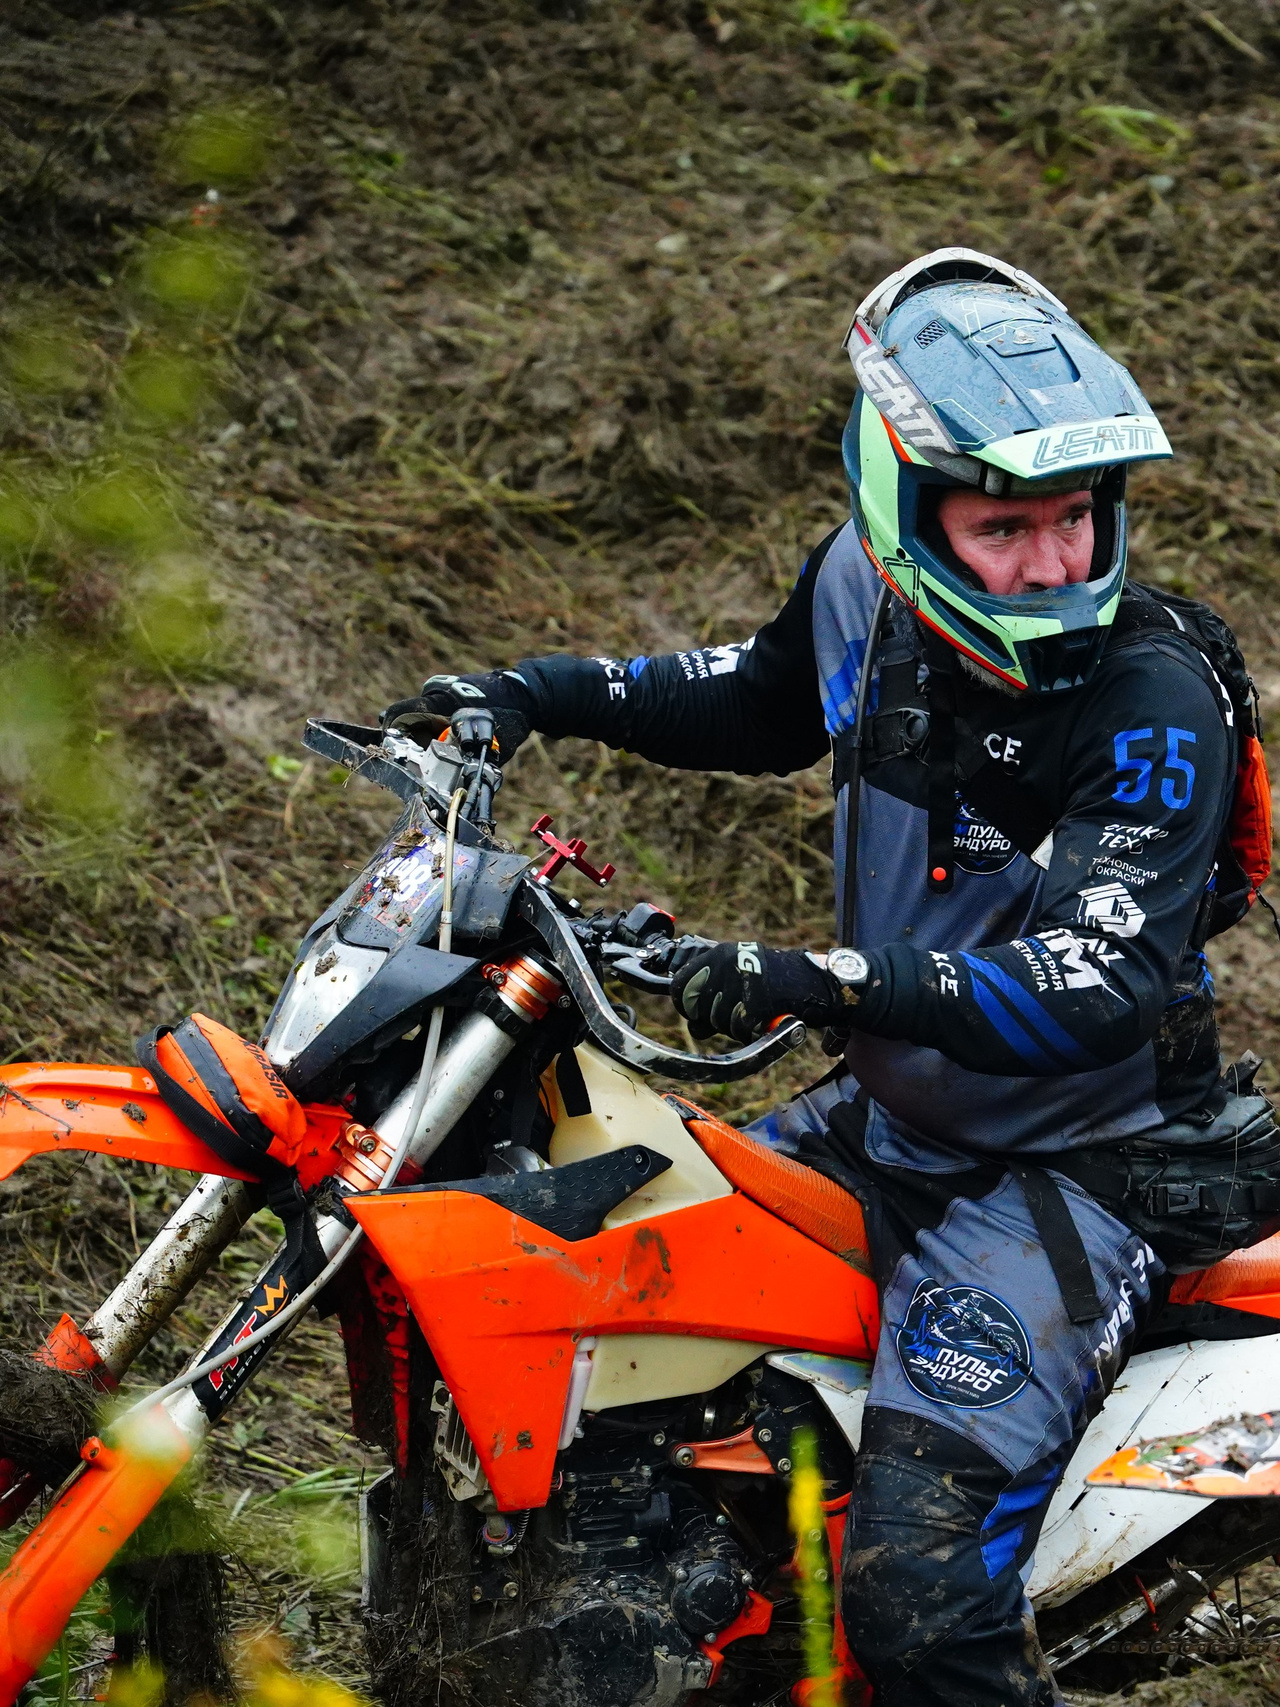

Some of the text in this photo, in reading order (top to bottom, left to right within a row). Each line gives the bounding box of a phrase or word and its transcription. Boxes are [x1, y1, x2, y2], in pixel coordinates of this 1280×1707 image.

[853, 344, 958, 455] LEATT
[1033, 425, 1158, 469] LEATT
[1111, 727, 1197, 811] 55
[1096, 865, 1146, 887] ОКРАСКИ
[908, 1355, 993, 1392] ЭНДУРО
